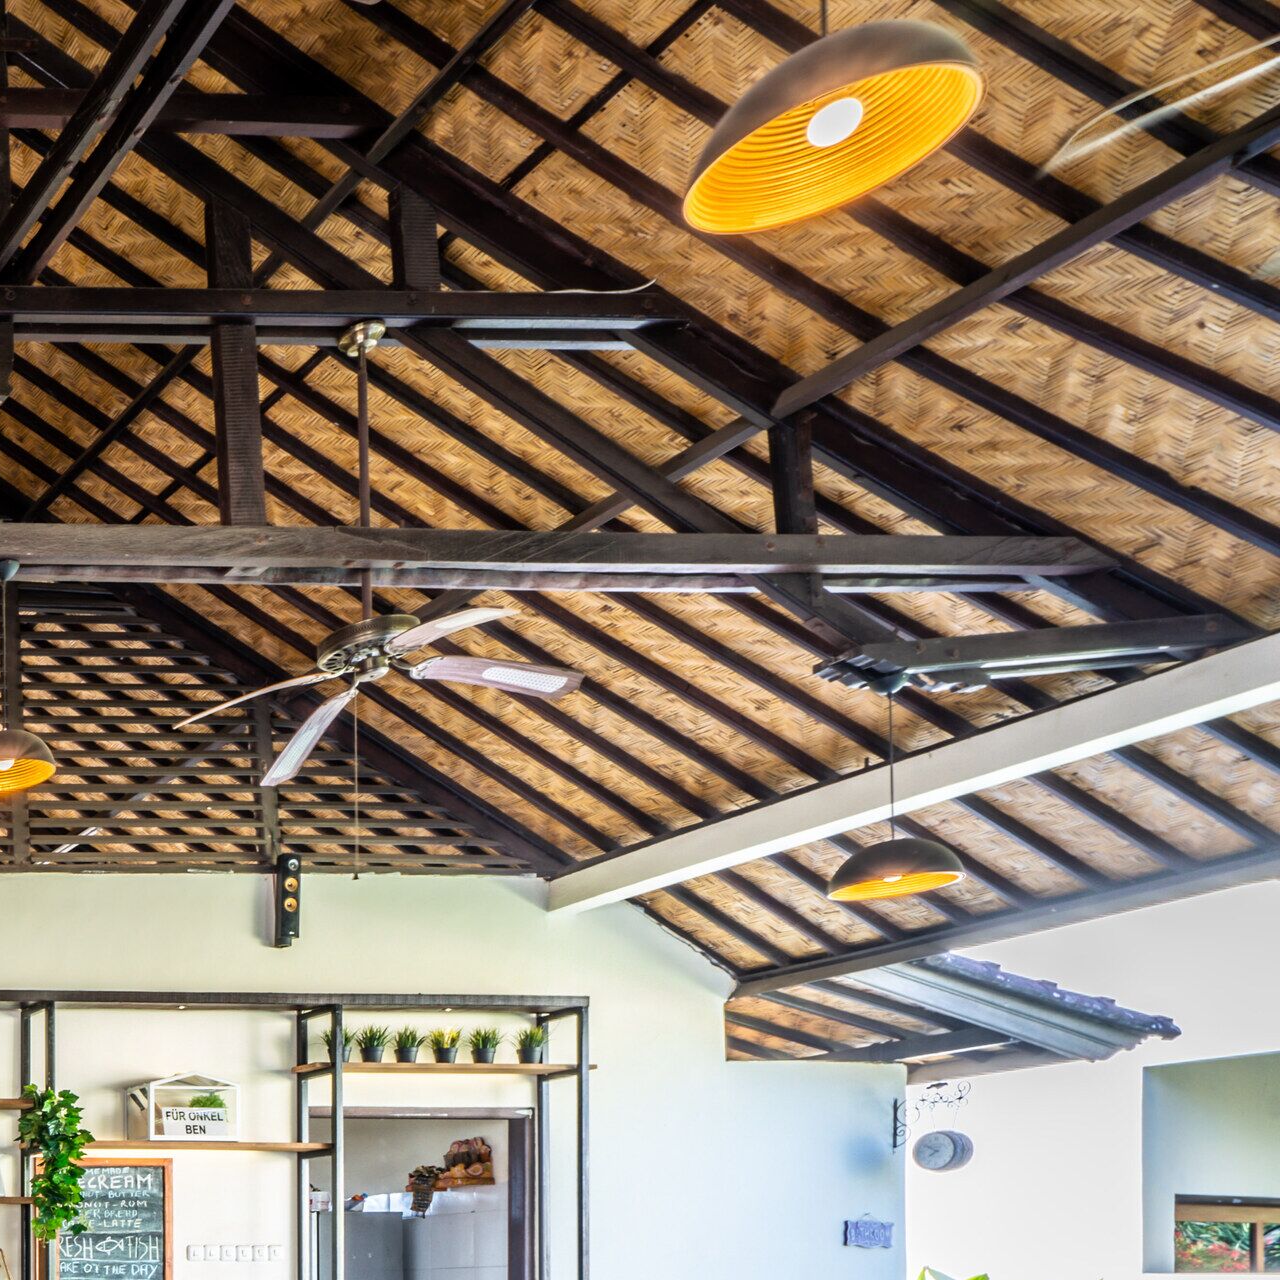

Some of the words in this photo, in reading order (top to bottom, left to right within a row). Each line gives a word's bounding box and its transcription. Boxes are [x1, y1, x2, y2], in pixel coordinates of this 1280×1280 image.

[165, 1108, 186, 1121] FÜR
[188, 1111, 224, 1121] ONKEL
[185, 1124, 206, 1135] BEN
[85, 1166, 130, 1175] MEMADE
[77, 1173, 152, 1190] ECREAM
[59, 1235, 93, 1259] RESH
[125, 1234, 160, 1261] FISH
[59, 1261, 80, 1274] AKE
[104, 1264, 127, 1275] THE
[131, 1264, 158, 1280] DAY
